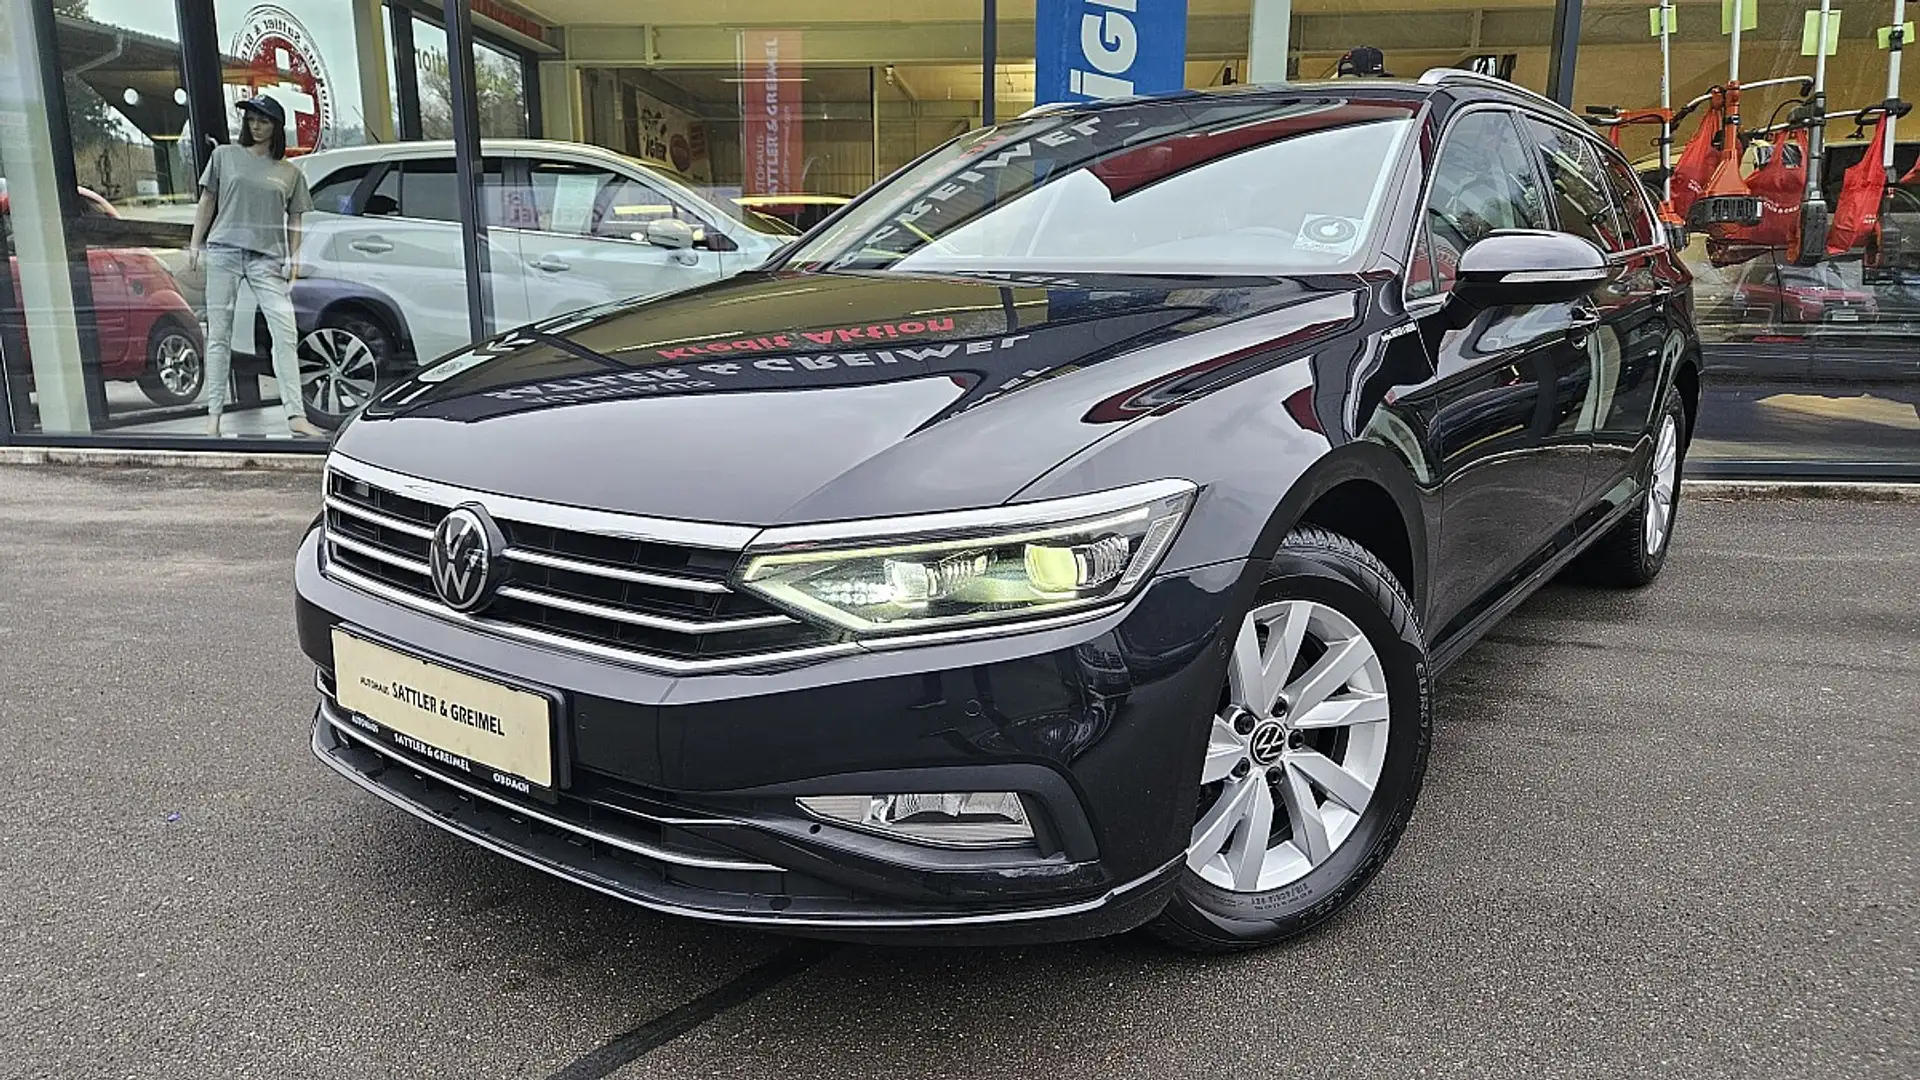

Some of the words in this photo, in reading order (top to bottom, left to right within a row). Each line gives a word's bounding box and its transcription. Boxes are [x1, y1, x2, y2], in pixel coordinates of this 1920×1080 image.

[766, 37, 779, 116] GREIMEL
[766, 118, 779, 132] &
[359, 676, 390, 696] AUTOHAUS
[392, 681, 437, 713] SATTLER
[439, 699, 448, 717] &
[451, 703, 505, 737] GREIMEL
[394, 732, 427, 755] SATTLER
[427, 745, 433, 758] &
[433, 749, 471, 772] GREIMEL
[493, 772, 530, 794] OBDACH
